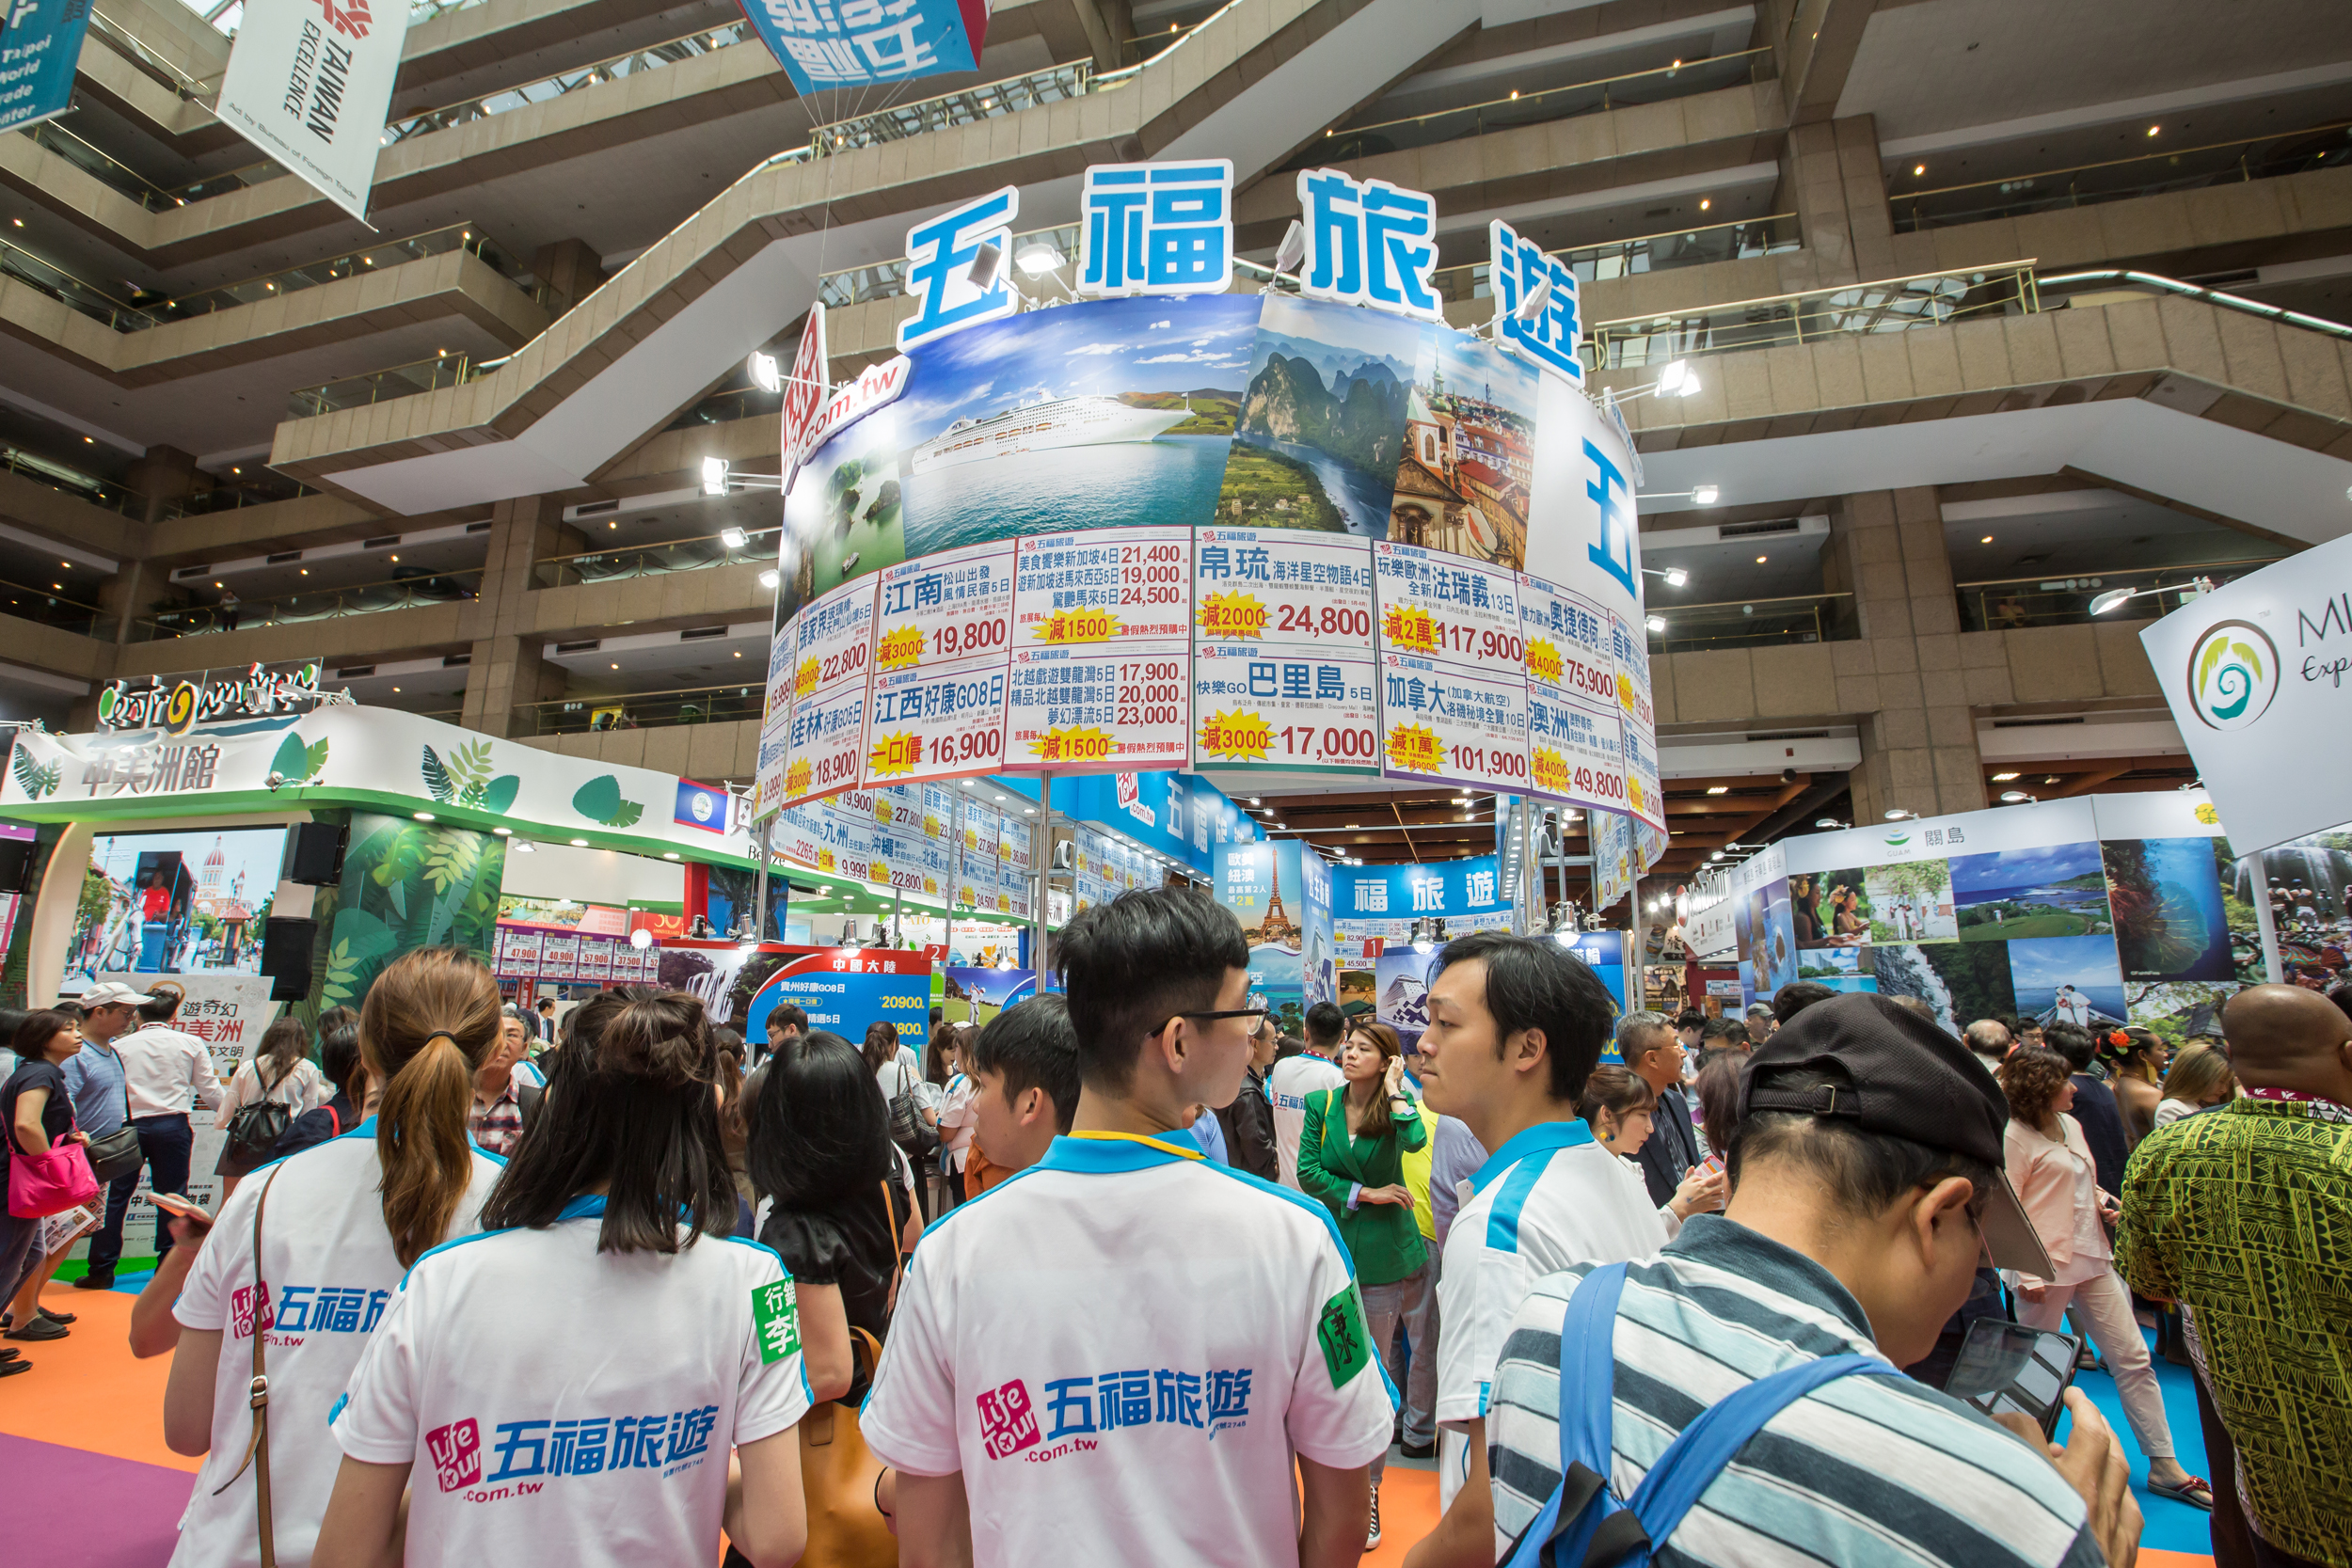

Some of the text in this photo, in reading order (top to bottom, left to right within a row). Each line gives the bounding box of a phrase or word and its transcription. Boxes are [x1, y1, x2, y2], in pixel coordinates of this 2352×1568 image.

[2, 34, 52, 63] Taipei
[283, 18, 321, 120] EXCELLENCE
[307, 38, 353, 145] TAIWAN
[229, 102, 357, 199] Ad by Bureau of Foreign Trade
[900, 162, 1581, 382] 五福旅遊
[802, 366, 898, 454] .com.tw
[1037, 537, 1073, 549] 五福旅遊
[1216, 531, 1257, 542] 五福旅遊
[1121, 546, 1180, 565] 21,400
[1392, 545, 1427, 559] 五福旅遊
[1120, 566, 1180, 586] 19,000
[1200, 546, 1371, 588] 帛琉 海洋星空物語4日
[1377, 557, 1431, 582] 玩樂歐洲
[884, 573, 943, 616] 江南
[943, 565, 990, 585] 松山出發
[943, 578, 1009, 601] 風情民宿5日
[1120, 587, 1180, 607] 24,500
[1408, 566, 1515, 615] 全新 法瑞義 13日
[799, 606, 826, 651] 張家界
[1049, 618, 1107, 641] 減1500
[1203, 604, 1370, 638] 減2000 24,800
[1550, 600, 1598, 649] 奧捷德荷
[879, 618, 1006, 662] 減3000 19,800
[1386, 613, 1432, 645] 減2萬
[1437, 622, 1522, 661] 117,900
[1613, 627, 1631, 668] 首爾
[822, 642, 866, 683] 22,800
[1031, 650, 1069, 660] 五福旅遊
[1216, 647, 1258, 657] 五福旅遊
[1120, 662, 1178, 684] 17,900
[1399, 657, 1433, 672] 五福旅遊
[1526, 649, 1613, 698] 減4000 75,900
[888, 673, 917, 686] 五福旅遊
[1197, 662, 1372, 701] 快樂GO 巴里島 5日
[1010, 685, 1178, 706] 精品北越雙龍灣5日 20,000
[1387, 673, 1510, 717] 加拿大 (加拿大航空)
[790, 700, 863, 751] 桂林 好康GO5日
[1048, 705, 1177, 727] 夢幻漂流5日 23,000
[1528, 700, 1570, 742] 澳洲
[871, 728, 1000, 767] 一口價 16,900
[1042, 736, 1108, 760] 減1500
[1203, 726, 1267, 751] 減3000
[1280, 726, 1375, 761] 17,000
[1391, 733, 1432, 754] 減1萬
[1451, 745, 1526, 778] 101,900
[82, 743, 223, 798] 中美洲館
[786, 772, 811, 793] 減3000
[816, 749, 856, 785] 18,900
[1535, 755, 1623, 800] 減4000 49,800
[842, 790, 871, 812] 19,900
[924, 787, 941, 810] 首爾
[896, 807, 920, 829] 27,800
[823, 820, 849, 847] 九州
[1924, 827, 1964, 847] 關島
[796, 839, 813, 861] 2265
[923, 848, 938, 869] 北越
[978, 838, 996, 856] 27,800
[1012, 849, 1028, 866] 36,800
[1886, 848, 1912, 857] GUAM
[842, 860, 867, 879] 9,999
[1228, 852, 1254, 866] 歐美
[892, 870, 921, 890] 22,800
[1228, 869, 1254, 882] 紐澳
[1228, 885, 1266, 895] 最高第2人
[1012, 900, 1027, 915] 27,800
[511, 947, 641, 965] 47,900 40,900 57,900 37,500
[930, 945, 940, 959] 2
[1371, 941, 1376, 957] 1
[833, 959, 897, 973] 中國大陸
[781, 982, 845, 993] 貴州好康GO8日
[182, 1000, 238, 1017] 遊奇幻
[978, 1386, 1024, 1431] Life
[1044, 1368, 1253, 1442] 五福旅遊
[431, 1423, 473, 1462] Life
[486, 1405, 719, 1483] 五福旅遊
[984, 1411, 1038, 1459] Tour
[1025, 1437, 1098, 1463] .com.tw
[437, 1449, 482, 1493] Tour
[463, 1481, 545, 1504] .com.tw
